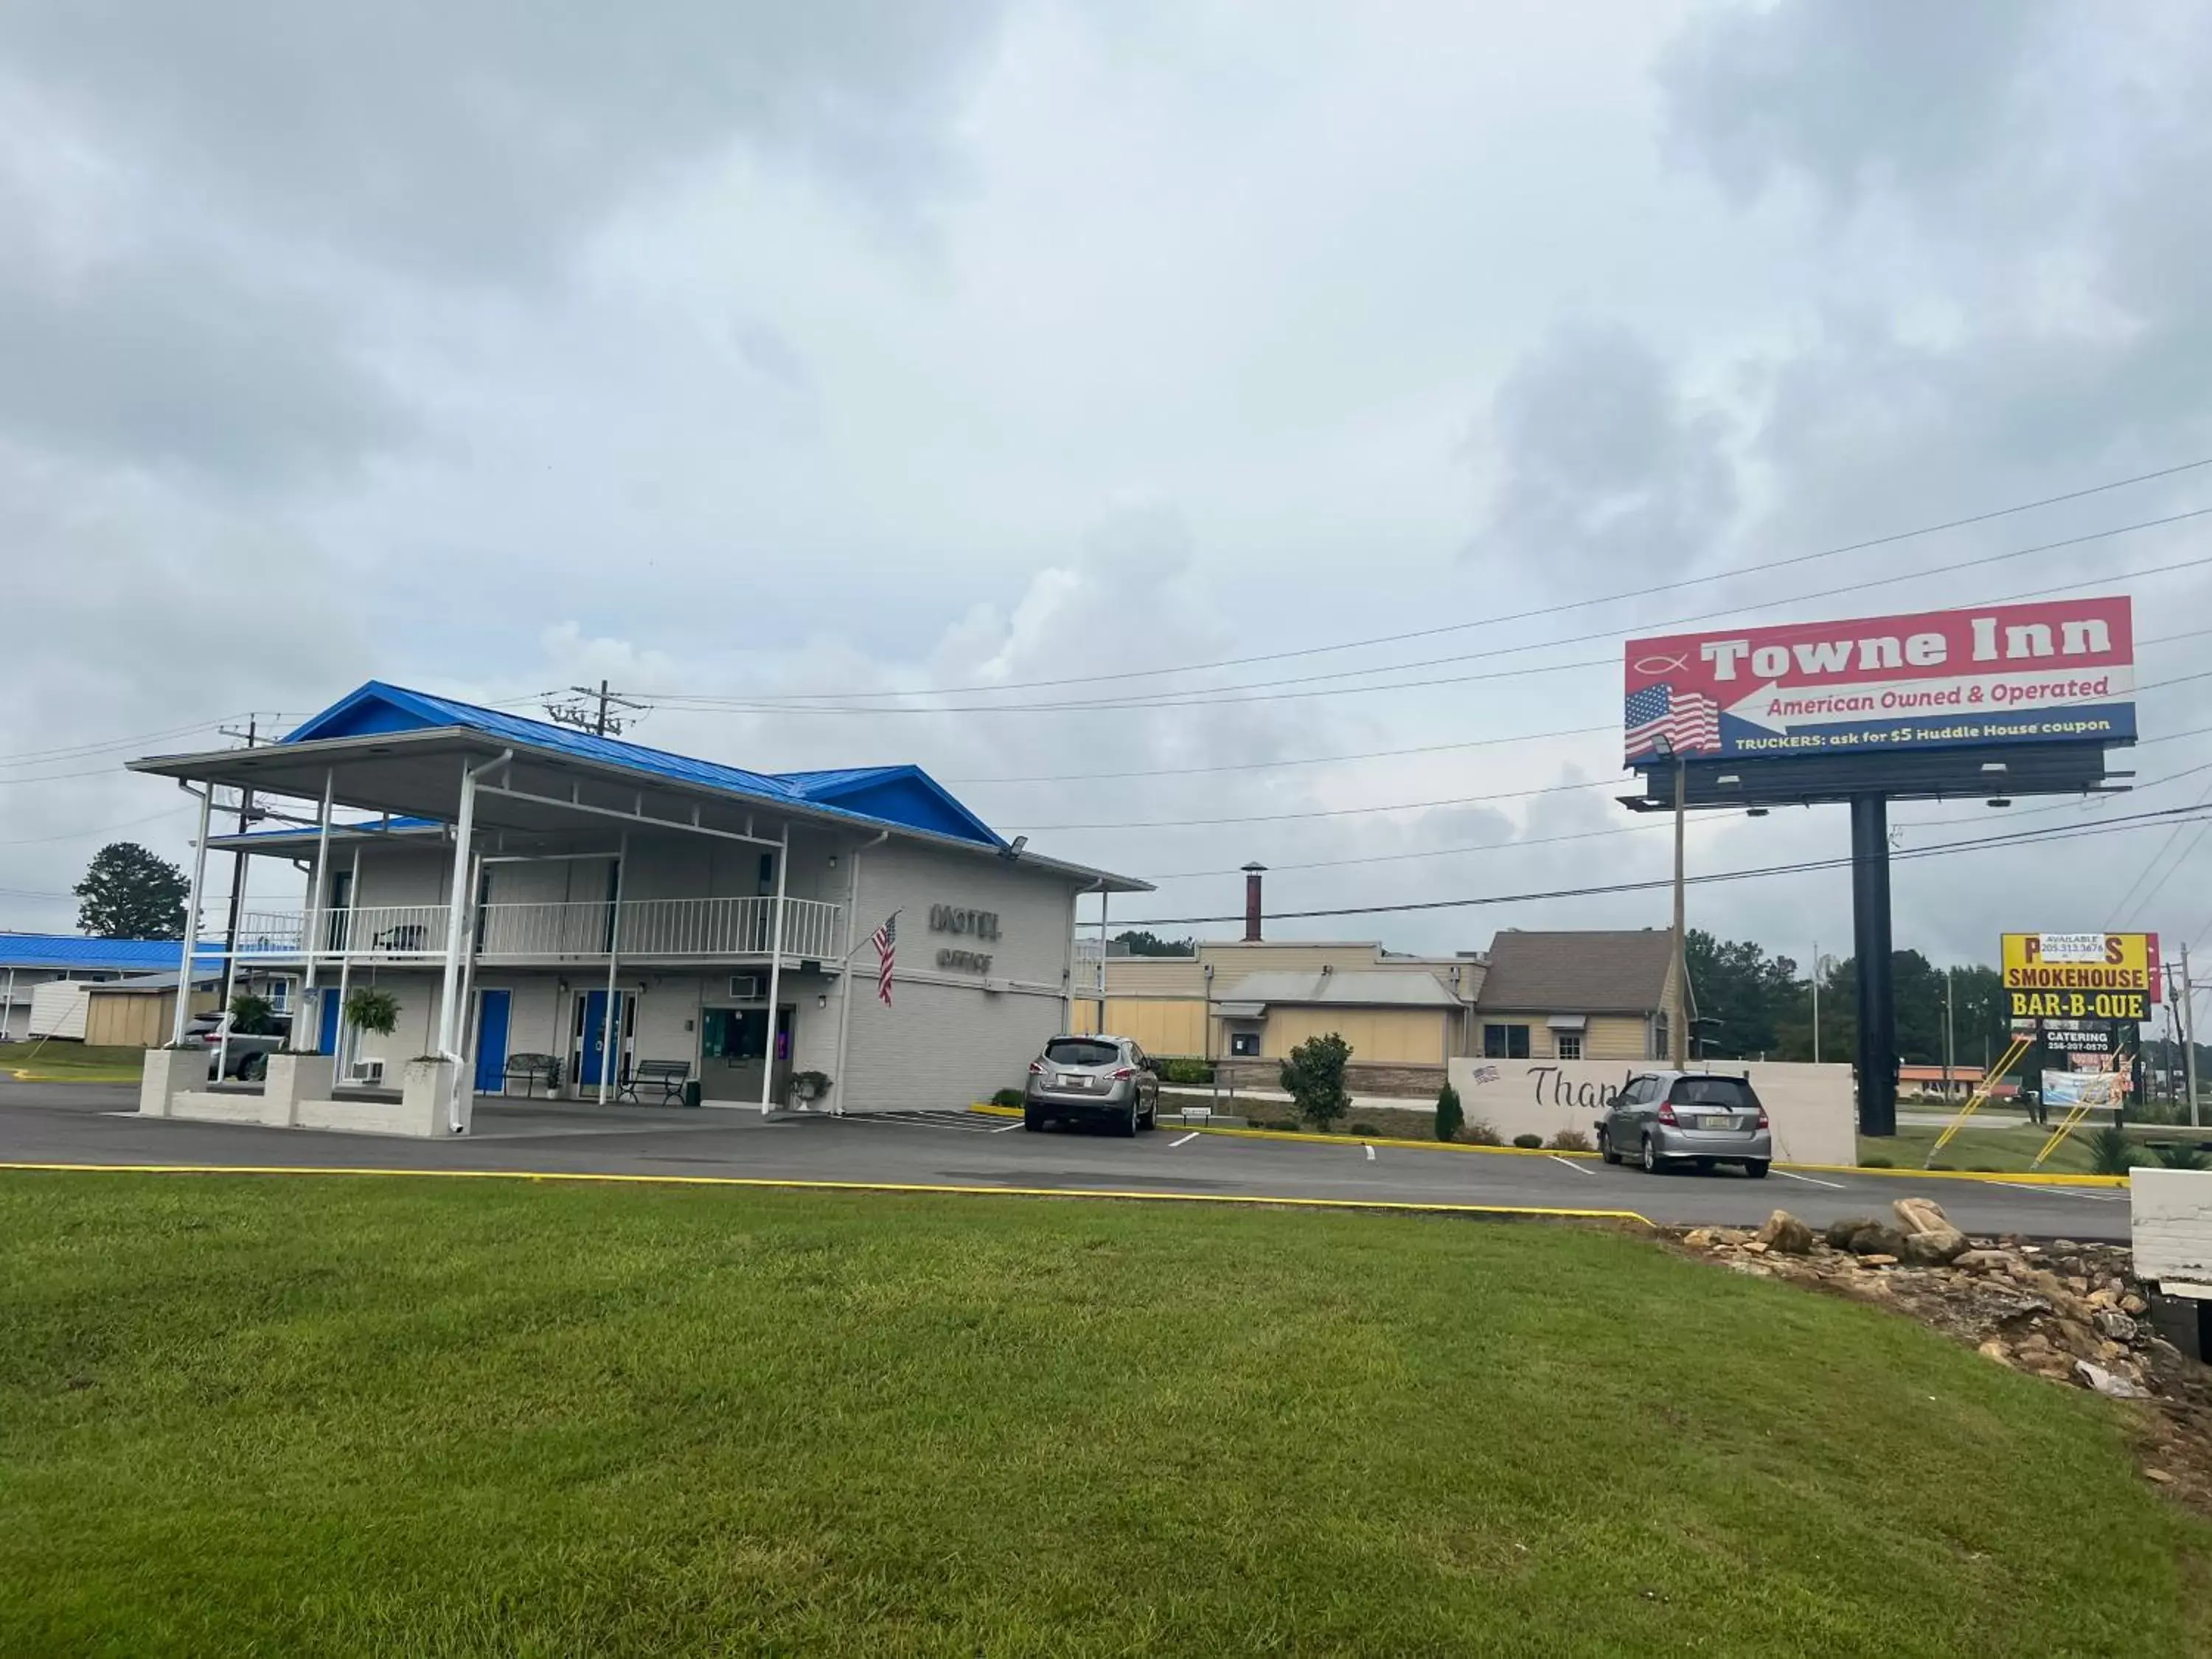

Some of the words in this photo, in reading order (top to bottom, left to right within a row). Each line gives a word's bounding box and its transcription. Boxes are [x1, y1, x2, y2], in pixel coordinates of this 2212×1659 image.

[1701, 632, 1947, 681] Towne
[1971, 618, 2111, 661] Inn
[1767, 695, 1874, 717] American
[1881, 686, 1961, 708] Owned
[1967, 686, 1984, 702] &
[1991, 675, 2109, 705] Operated
[1736, 734, 1826, 750] TRUCKERS:
[1830, 732, 1859, 745] ask
[1863, 731, 1888, 743] for
[1891, 727, 1913, 742] $5
[1916, 725, 1980, 740] Huddle
[1983, 723, 2039, 737] House
[2042, 720, 2111, 734] coupon
[2009, 968, 2143, 988] SMOKEHOUSE
[2011, 993, 2144, 1018] BAR-B-QUE
[2048, 1032, 2108, 1042] CATERING
